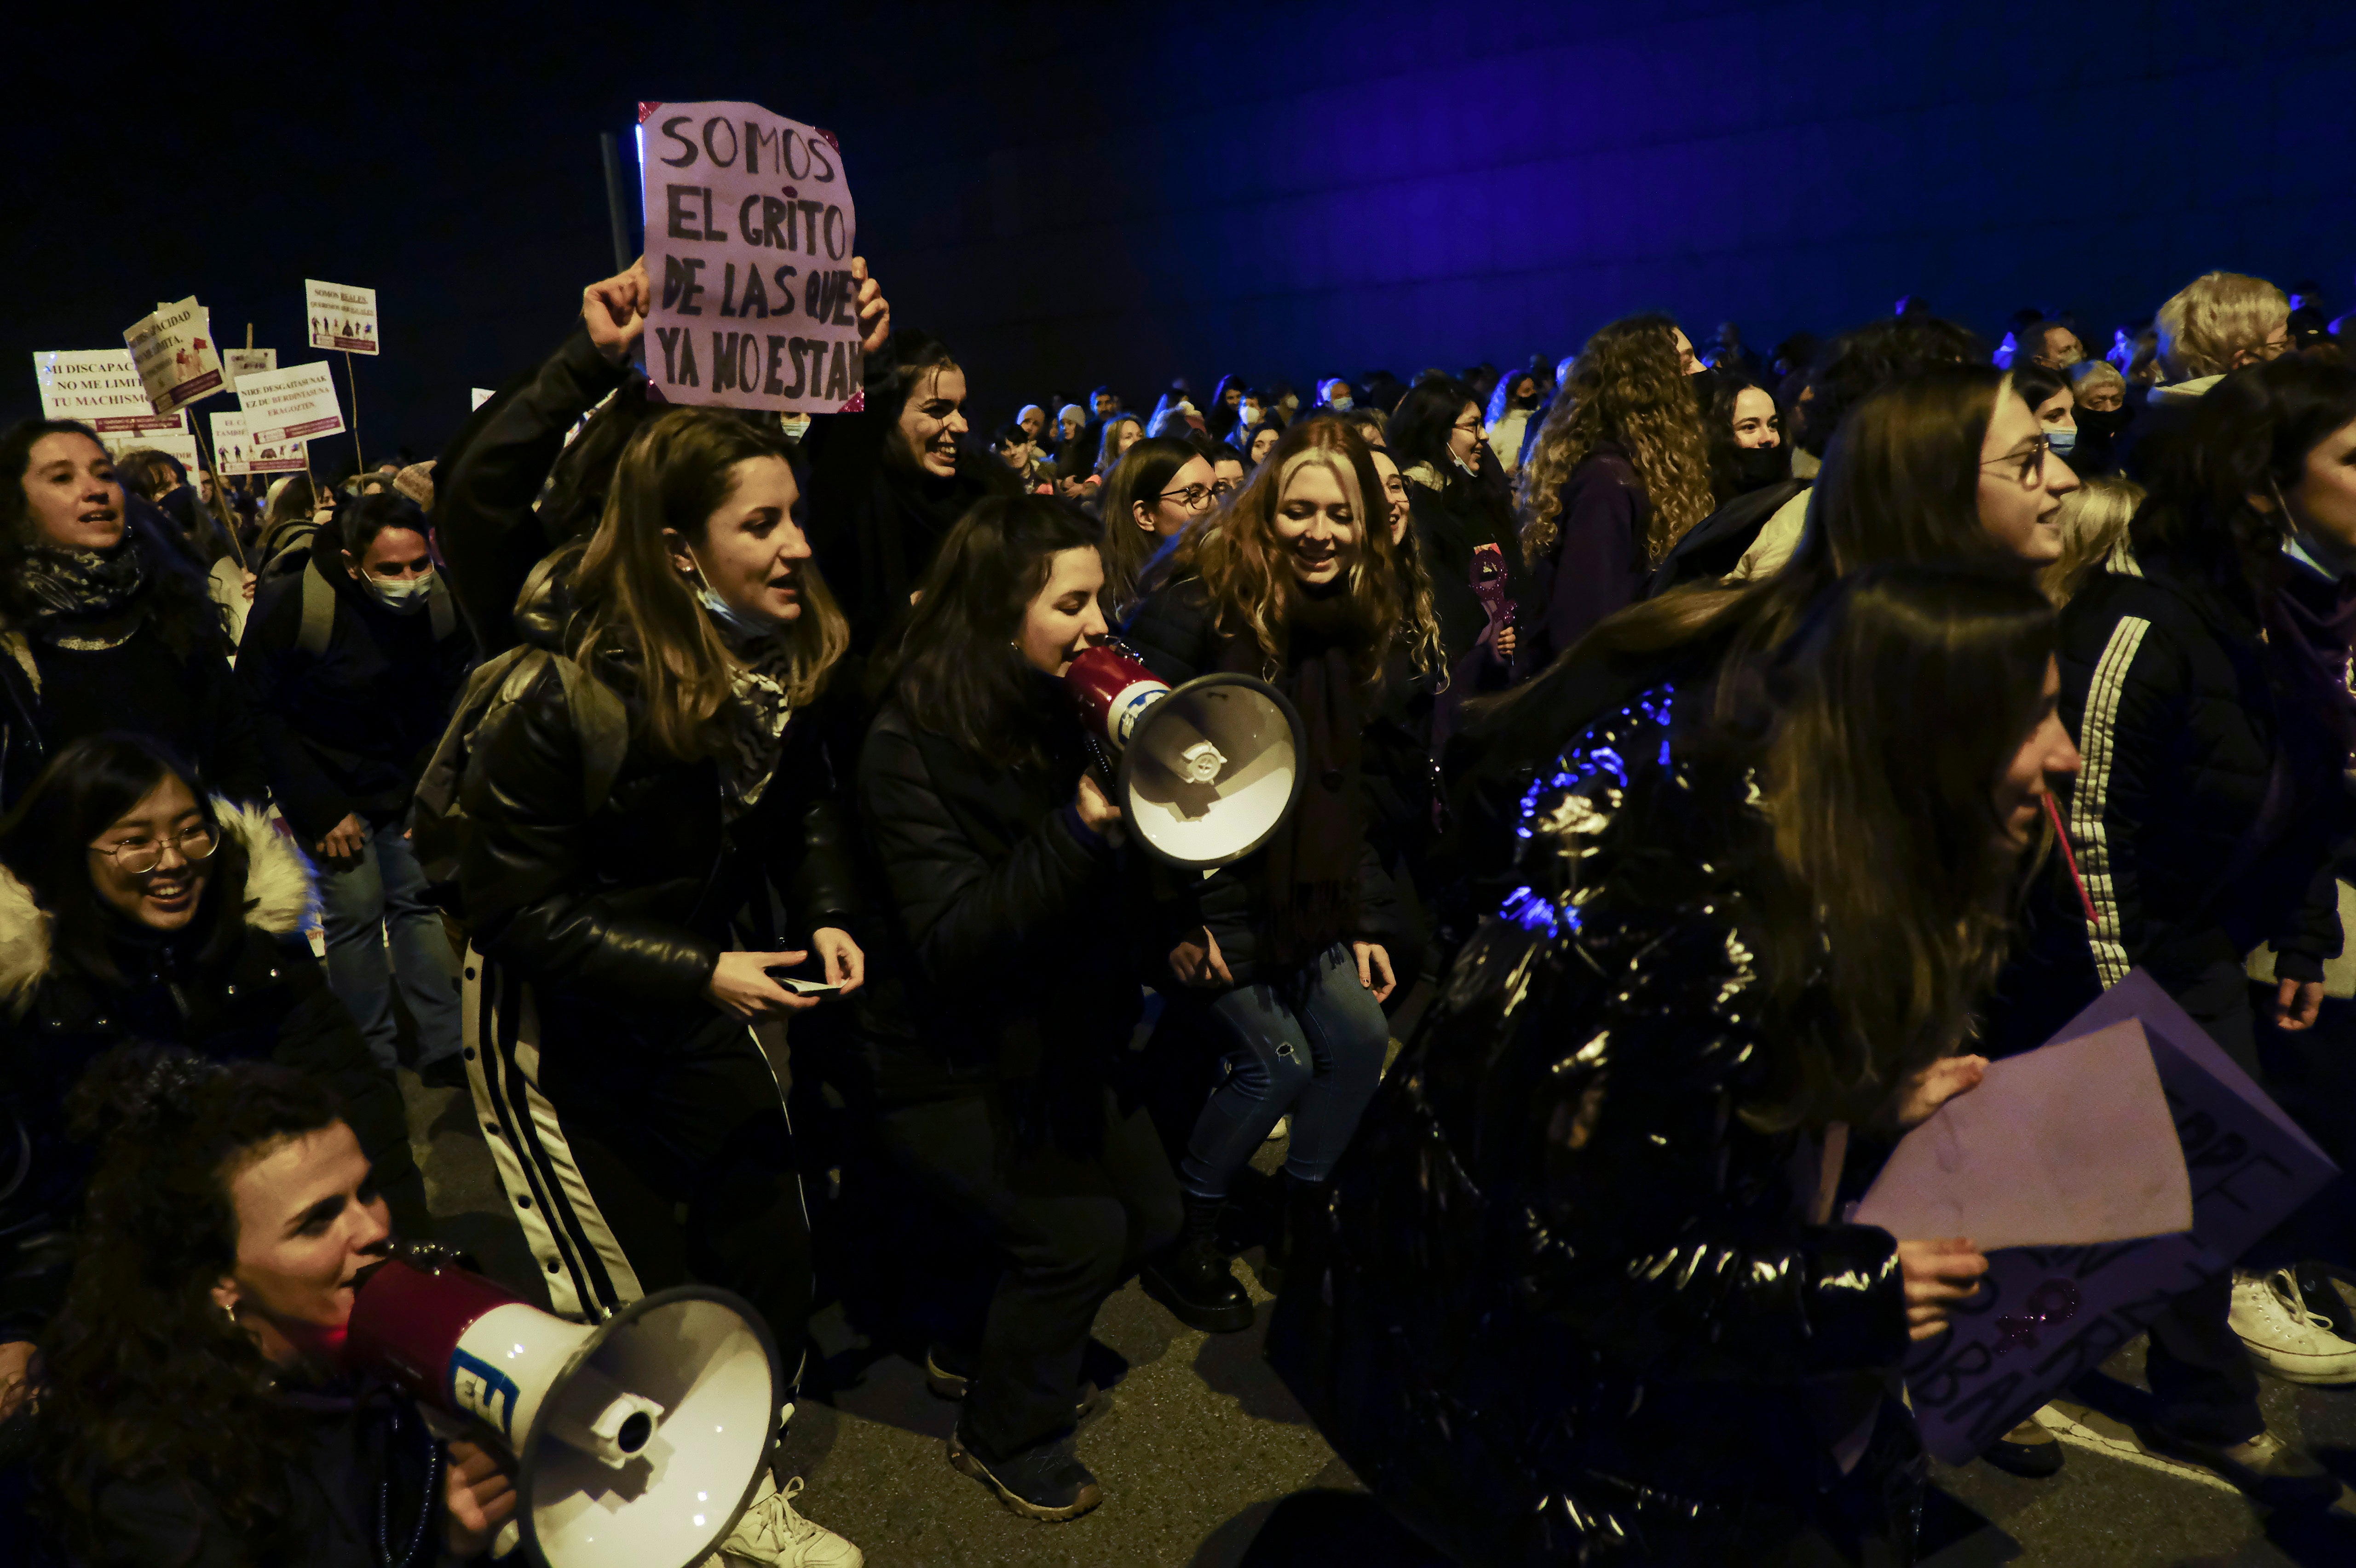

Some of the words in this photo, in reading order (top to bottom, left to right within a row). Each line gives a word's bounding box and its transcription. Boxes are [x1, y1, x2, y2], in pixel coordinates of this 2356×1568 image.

[661, 116, 835, 183] SOMOS
[667, 184, 727, 241] EL
[663, 254, 706, 315] DE
[720, 262, 797, 318] LAS
[806, 270, 855, 326] QUE
[656, 327, 699, 387] YA
[713, 332, 759, 393] NO
[67, 362, 135, 374] DISCAPAC
[58, 381, 77, 391] NO
[81, 380, 101, 390] ME
[105, 378, 143, 388] LIMIT
[241, 388, 262, 397] NIRE
[52, 397, 72, 407] TU
[246, 400, 257, 408] EZ
